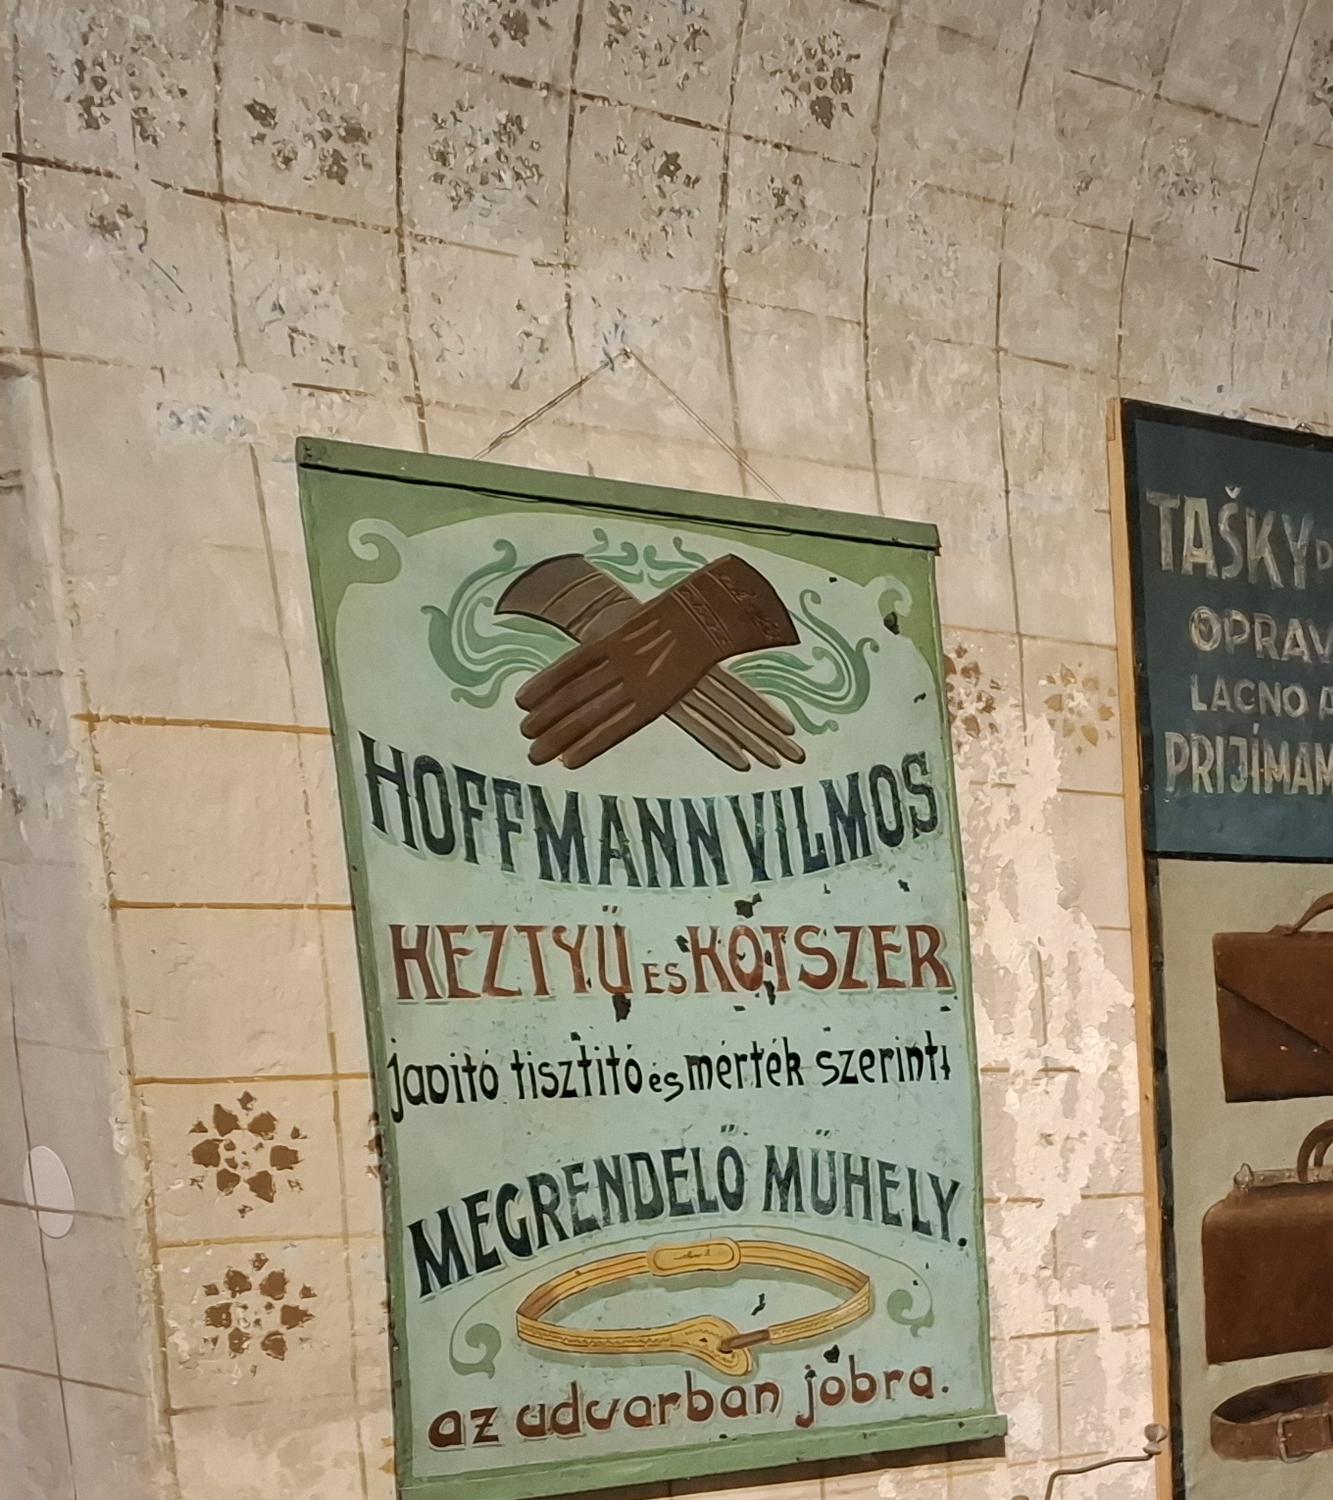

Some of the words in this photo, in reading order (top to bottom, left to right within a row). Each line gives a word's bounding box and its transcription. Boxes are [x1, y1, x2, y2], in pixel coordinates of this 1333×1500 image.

[1146, 486, 1314, 589] TAŠKY
[1190, 675, 1308, 718] LACNO
[359, 733, 729, 888] HOFFMANN
[727, 751, 940, 883] VILMOS
[650, 1062, 684, 1102] és
[684, 1037, 804, 1090] mérték
[428, 1407, 500, 1448] az
